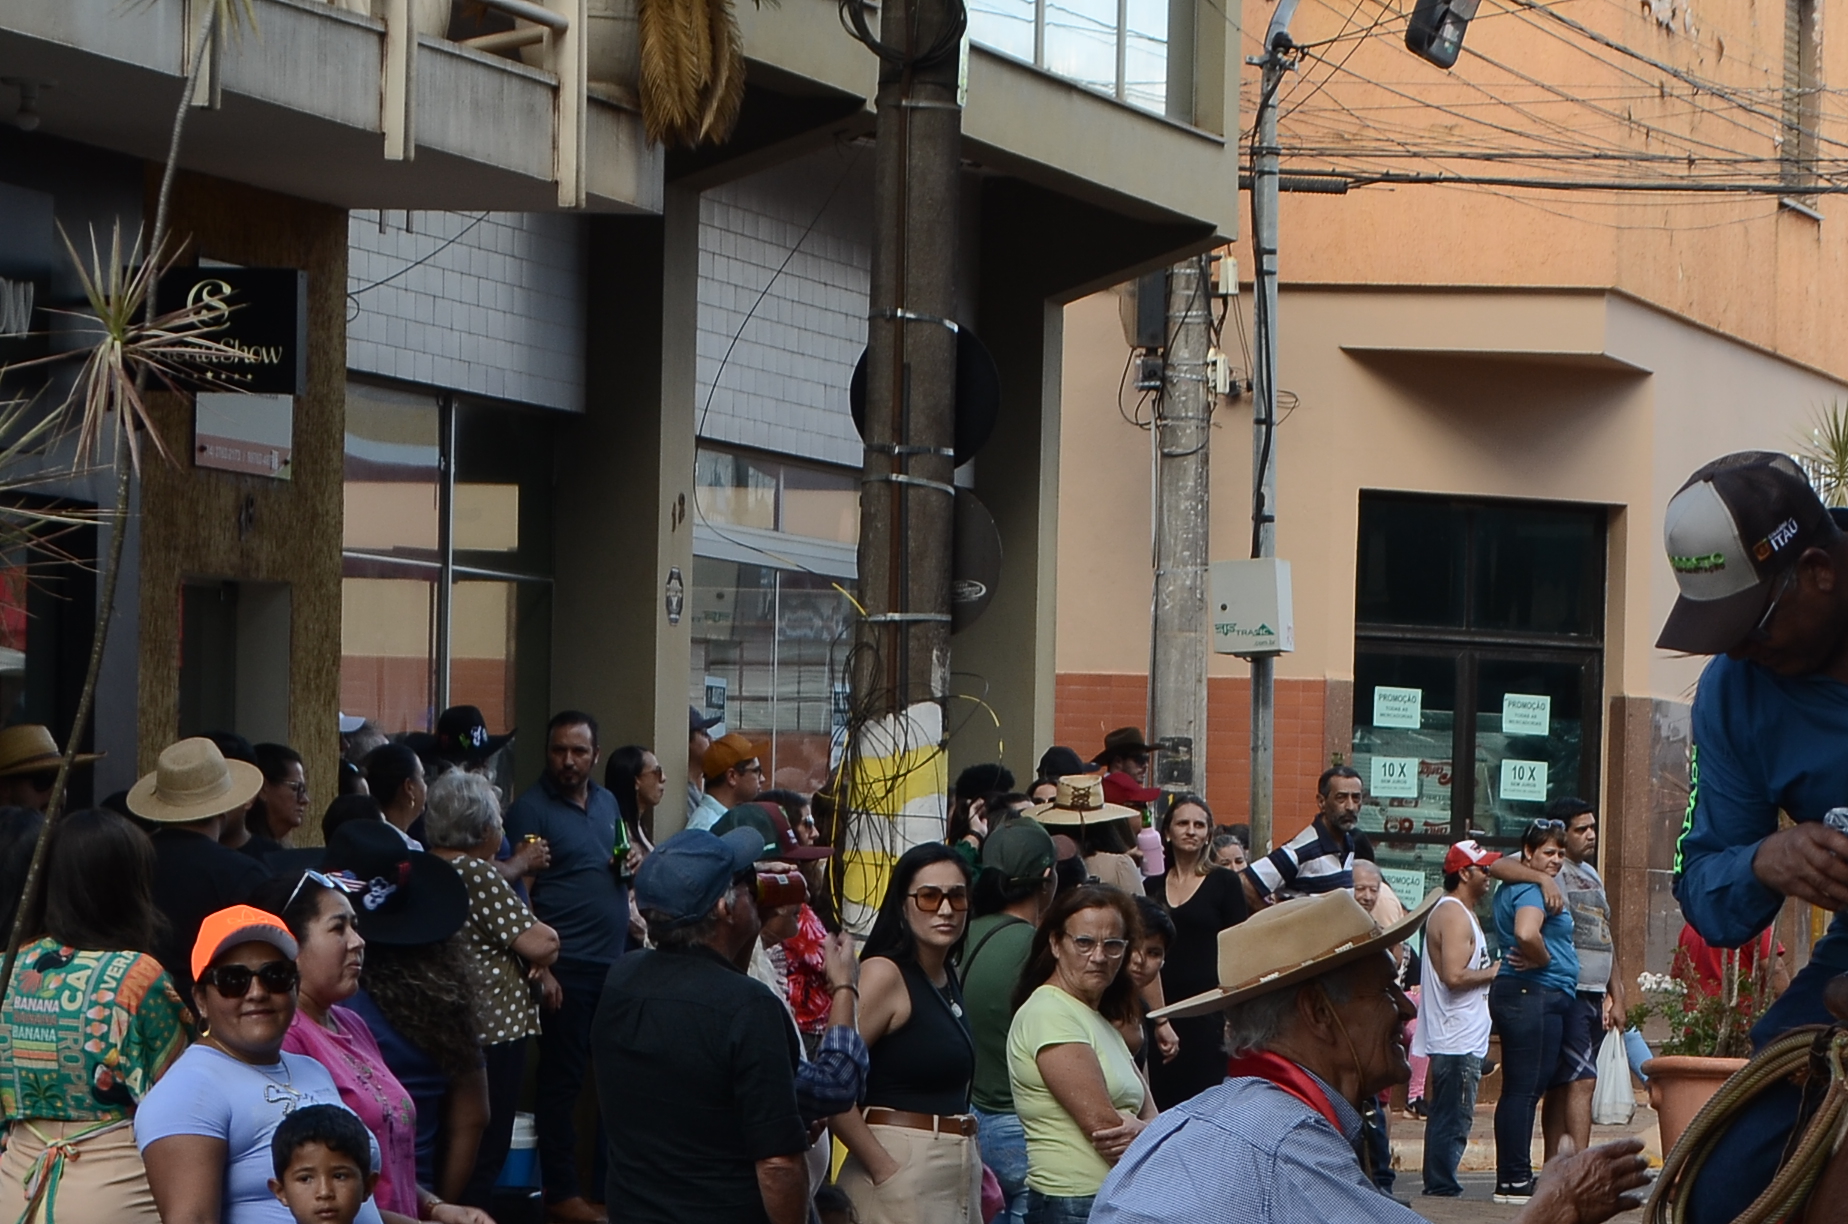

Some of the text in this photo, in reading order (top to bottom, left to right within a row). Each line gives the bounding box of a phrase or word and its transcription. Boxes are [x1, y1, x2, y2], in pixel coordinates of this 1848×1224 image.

[1770, 517, 1798, 551] ITAÚ
[1378, 692, 1417, 704] PROMOÇÃO
[1507, 700, 1546, 711] PROMOÇÃO
[1382, 762, 1407, 778] 10 X
[1512, 765, 1537, 781] 10 X
[14, 995, 60, 1013] BANANA
[13, 1011, 58, 1026] BANANA
[12, 1026, 57, 1042] BANANA
